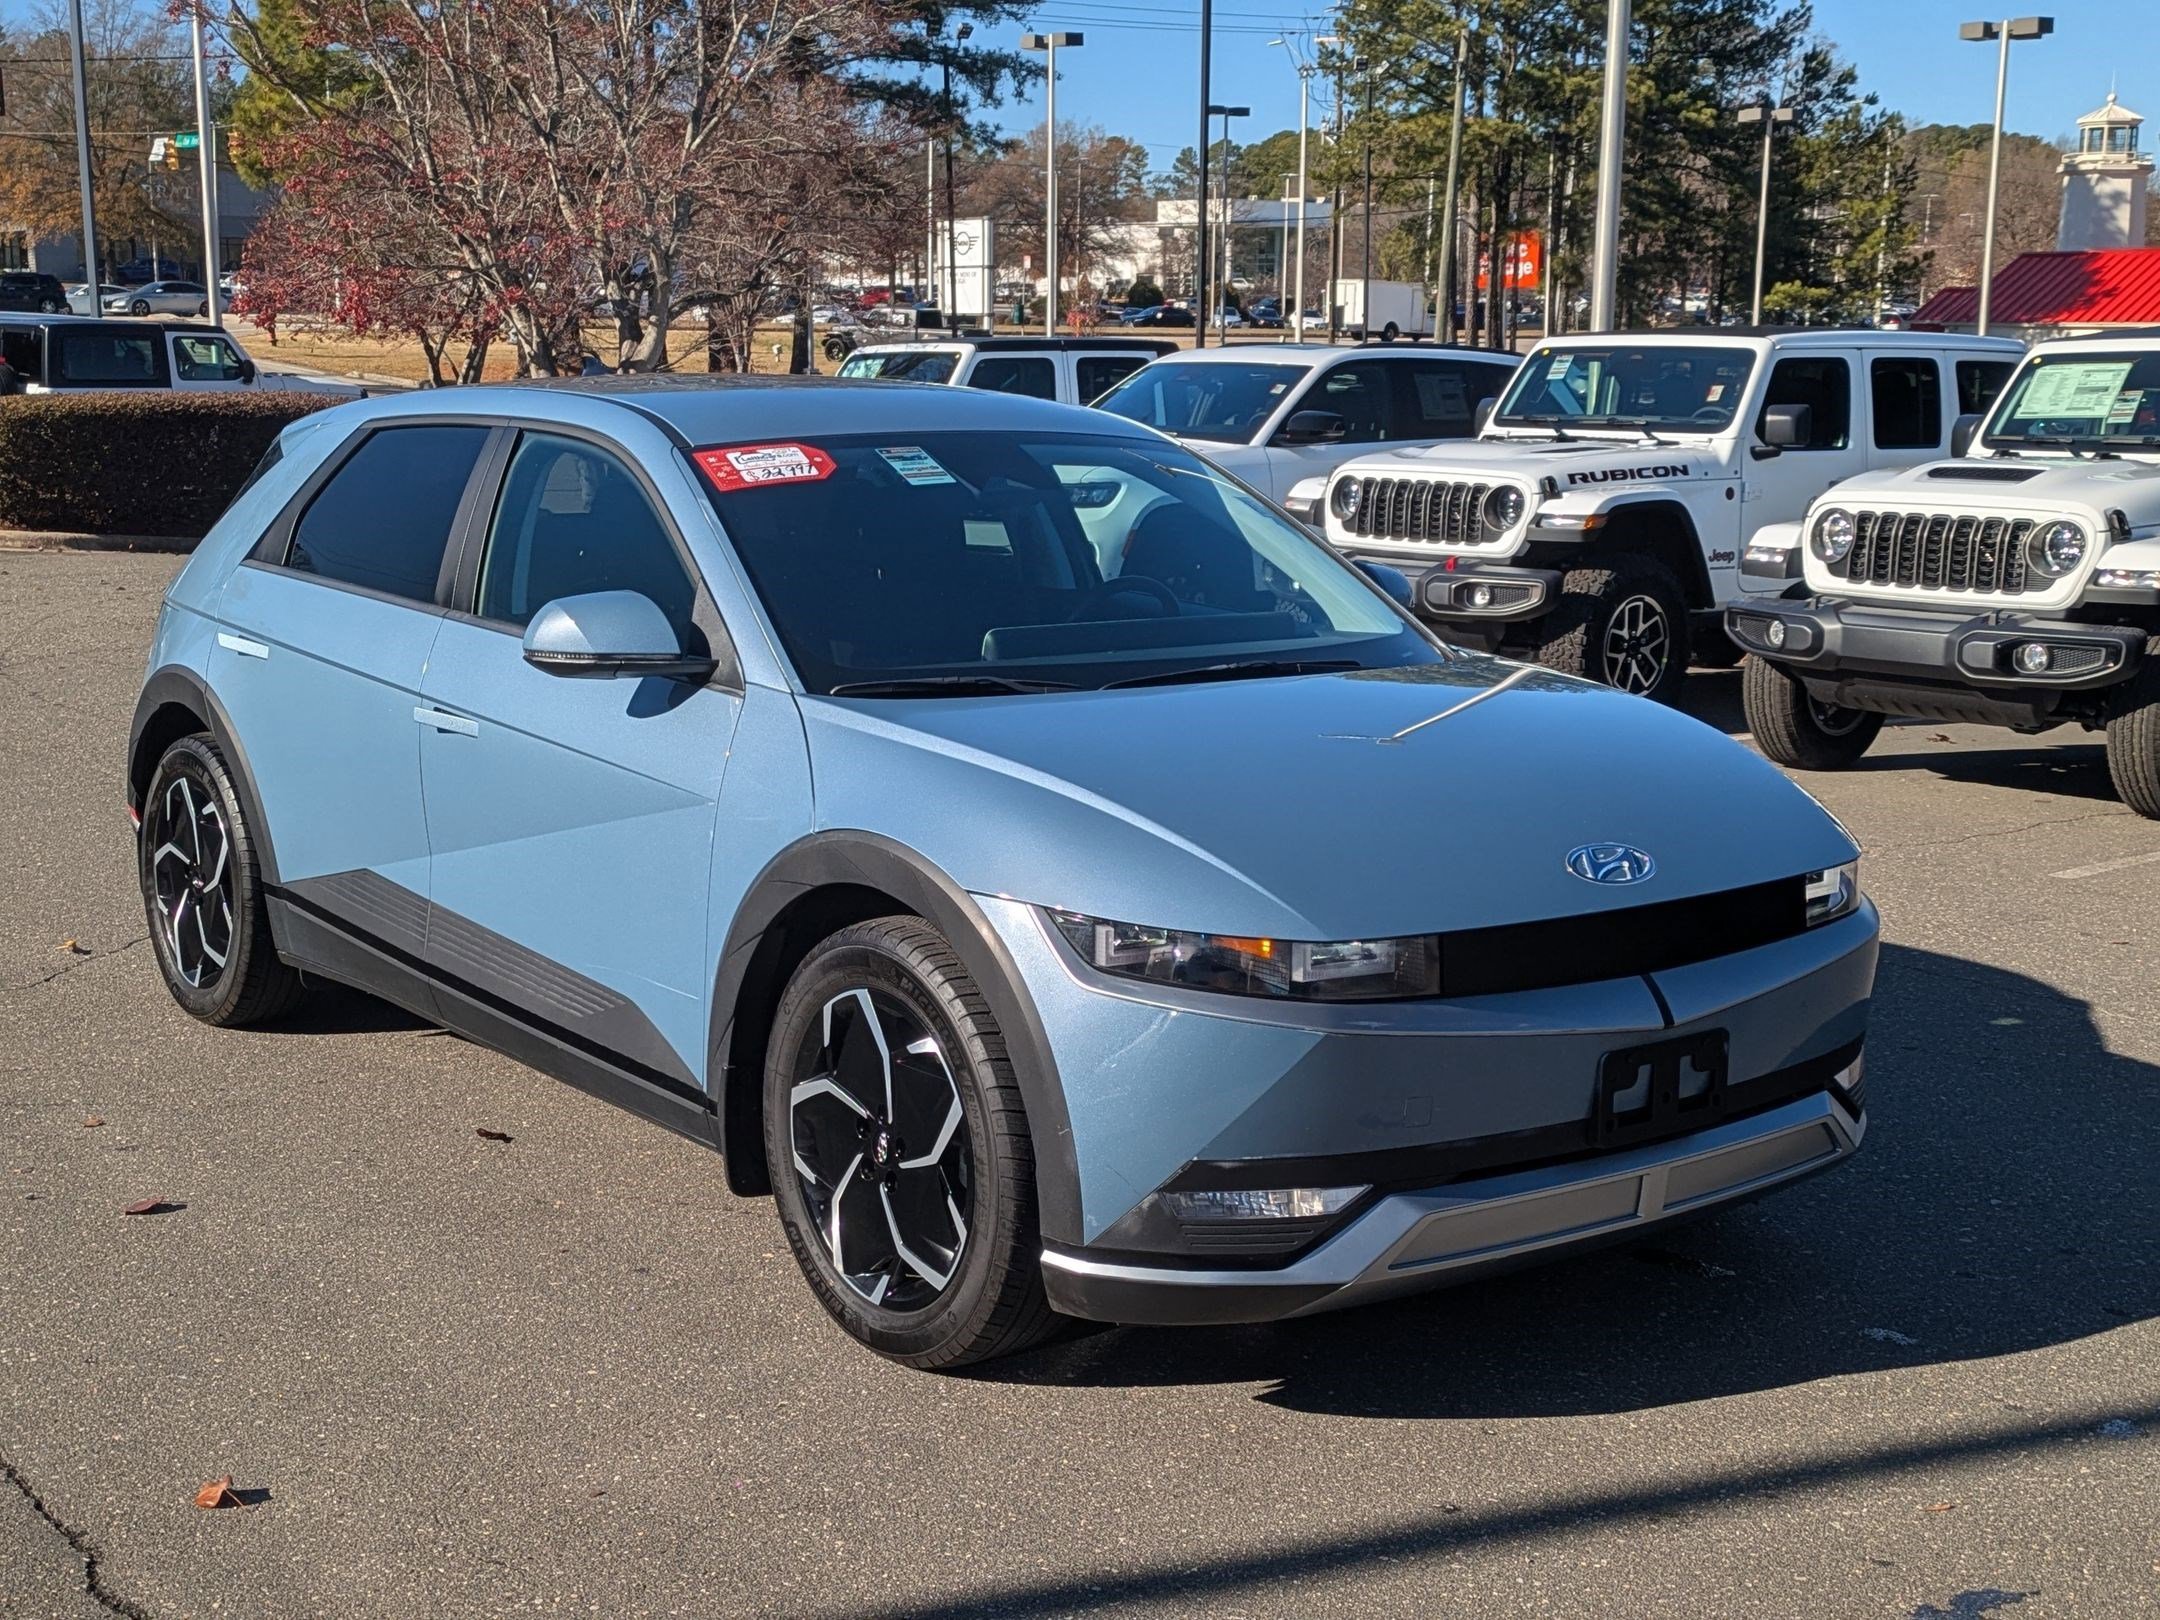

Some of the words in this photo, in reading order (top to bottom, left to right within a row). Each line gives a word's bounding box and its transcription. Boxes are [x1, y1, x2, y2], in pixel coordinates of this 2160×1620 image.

[1567, 464, 1690, 485] RUBICON
[1708, 548, 1735, 564] Jeep
[899, 974, 965, 1069] MICHELIN
